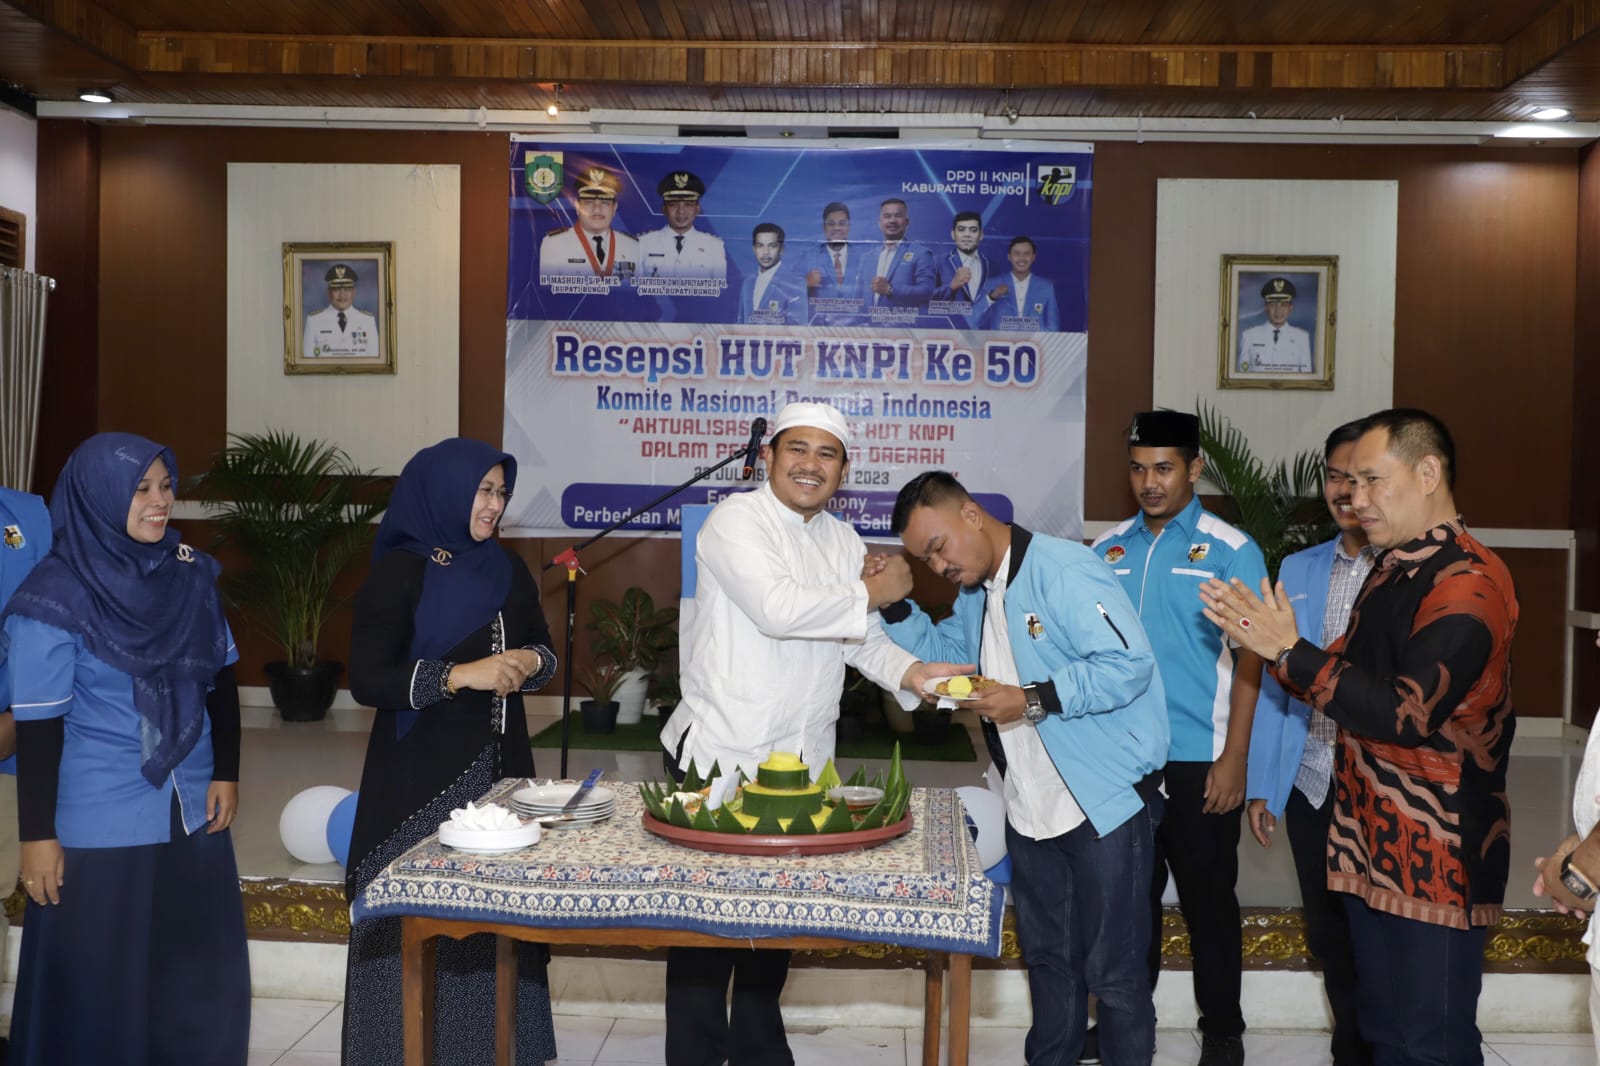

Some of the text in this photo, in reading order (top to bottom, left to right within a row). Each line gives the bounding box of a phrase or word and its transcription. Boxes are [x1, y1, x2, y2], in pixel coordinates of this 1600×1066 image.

[947, 170, 1025, 184] DPD II KNPI
[902, 181, 1025, 196] KABUPATEN BUNGO
[555, 335, 1037, 383] Resepsi HUT KNPI Ke 50
[596, 385, 672, 411] Komite
[680, 387, 776, 414] Nasional
[882, 392, 992, 419] Indonesia
[865, 423, 902, 440] HUT
[909, 424, 955, 441] KNPI
[641, 441, 708, 459] DALAM
[868, 446, 945, 465] DAERAH
[855, 471, 890, 485] 2023
